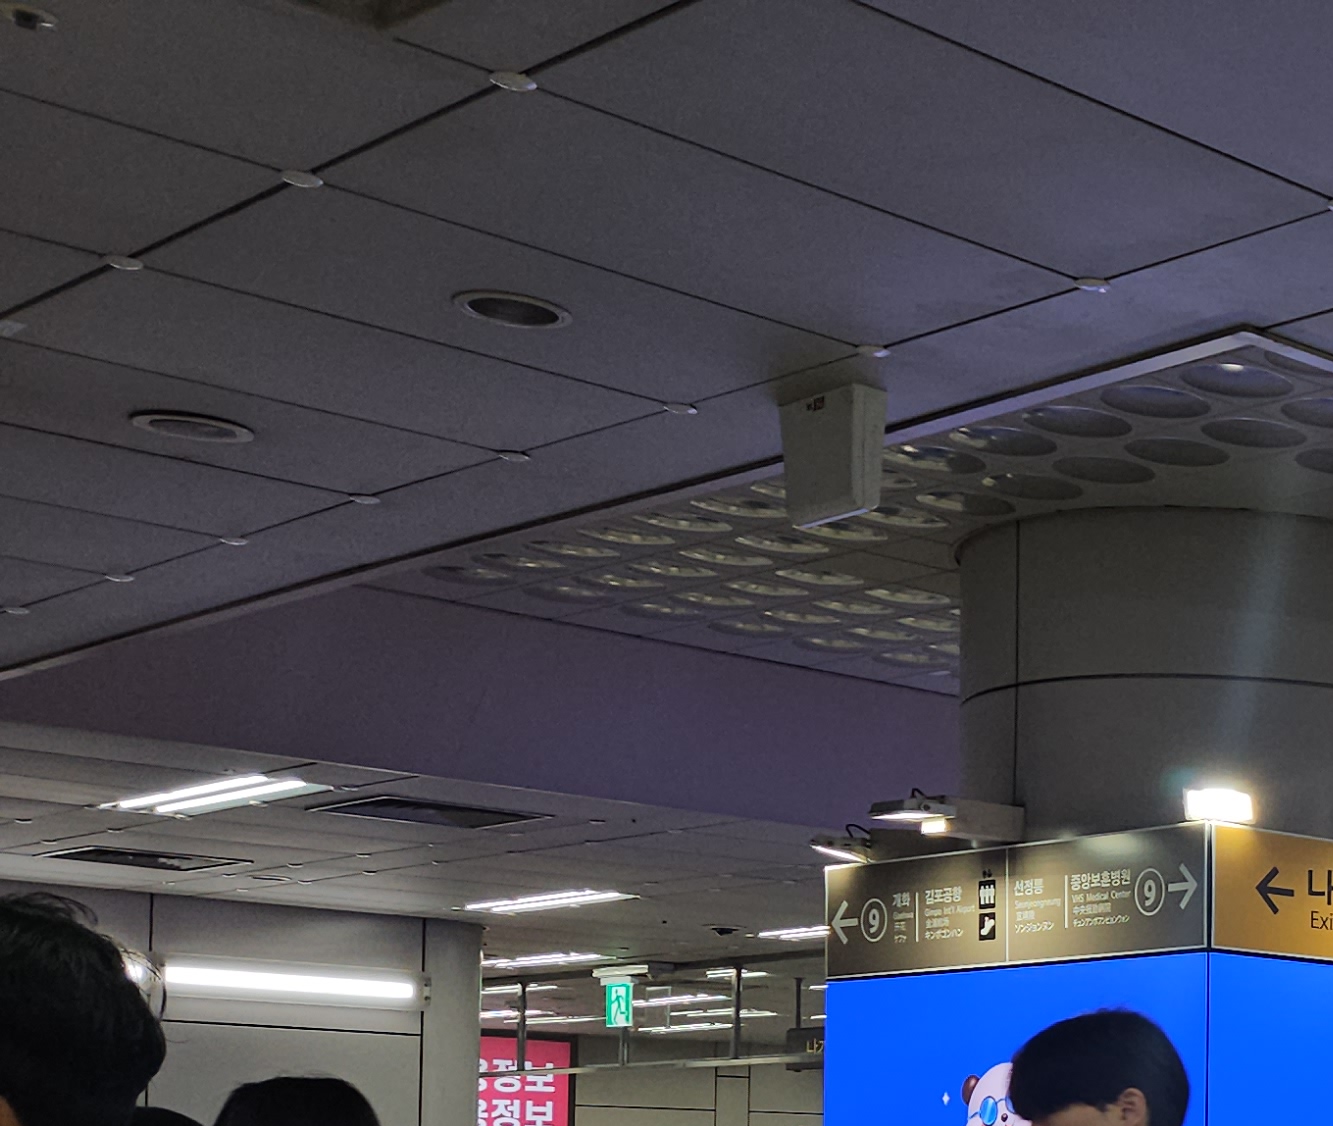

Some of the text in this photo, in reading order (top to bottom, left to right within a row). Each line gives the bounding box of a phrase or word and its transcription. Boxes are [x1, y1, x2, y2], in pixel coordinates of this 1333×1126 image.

[1013, 878, 1045, 897] 선정릉
[1070, 868, 1132, 891] 중앙보훈병원
[924, 886, 963, 905] 김포공항
[478, 1057, 556, 1094] 정보
